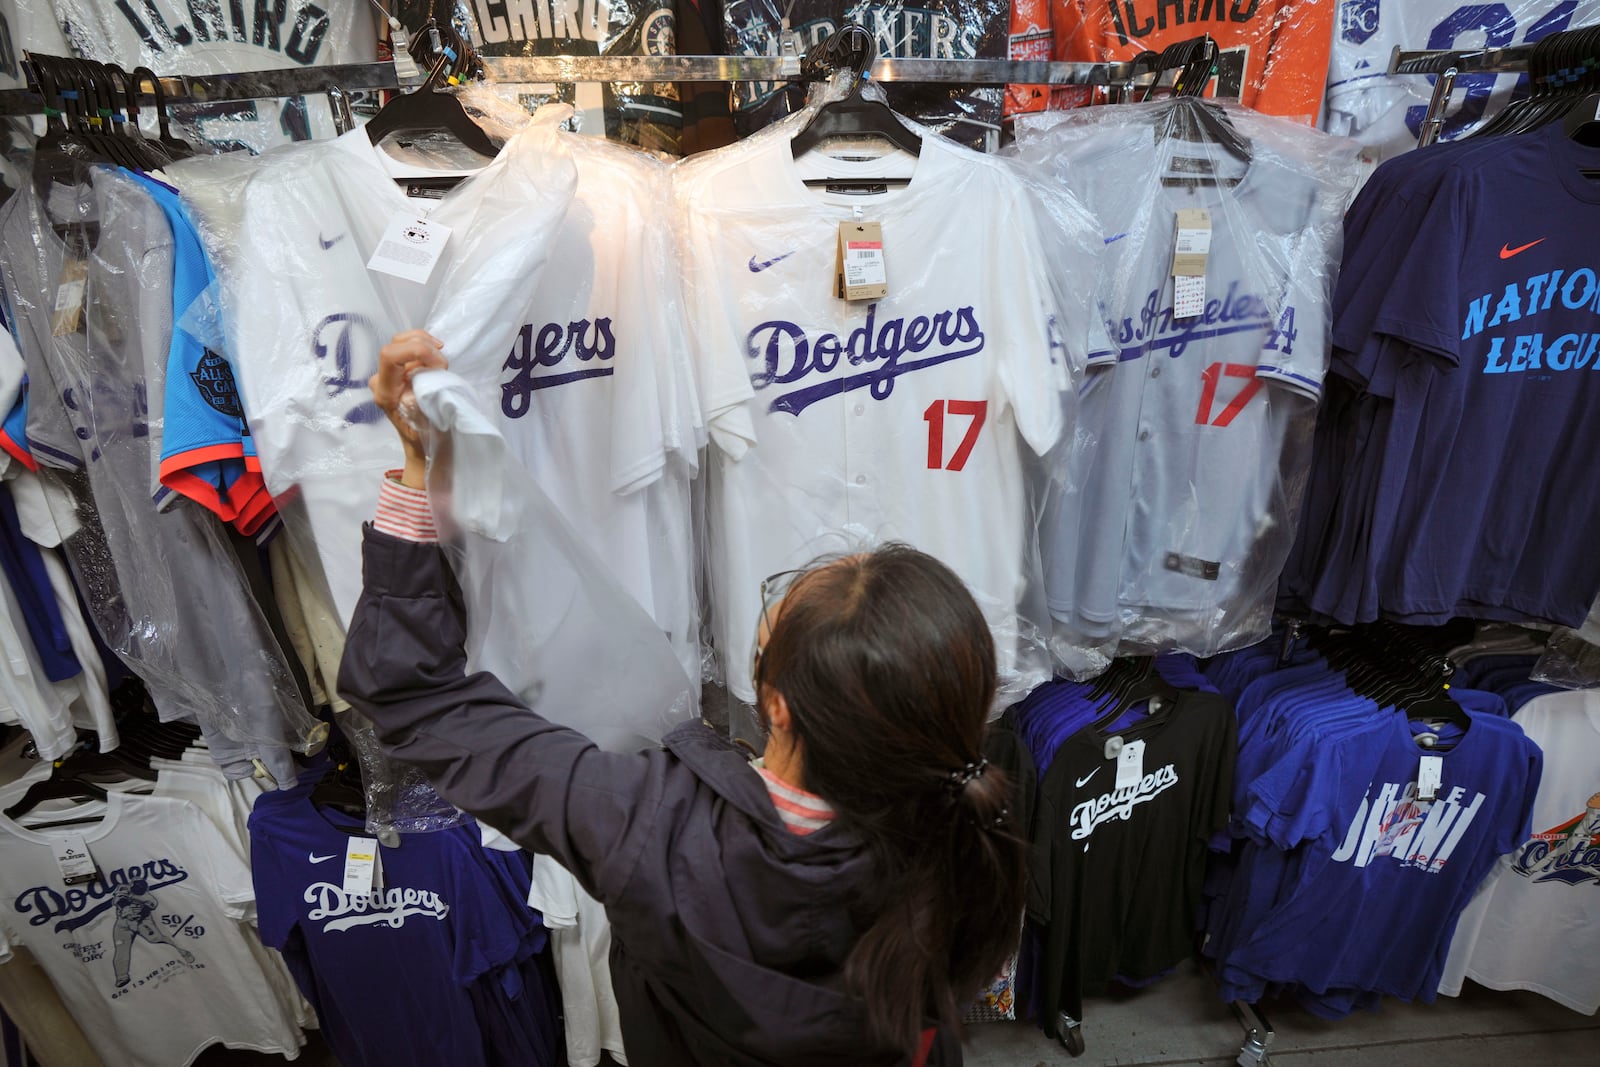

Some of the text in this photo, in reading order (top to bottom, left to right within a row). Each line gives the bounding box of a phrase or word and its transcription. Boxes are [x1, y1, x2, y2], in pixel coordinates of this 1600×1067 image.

[1345, 6, 1378, 36] KC
[746, 304, 985, 410] Dodgers
[1483, 333, 1600, 374] LEAGU
[1195, 362, 1263, 428] 17
[923, 399, 988, 472] 17
[14, 858, 188, 928] Dodgers
[303, 882, 450, 929] Dodgers
